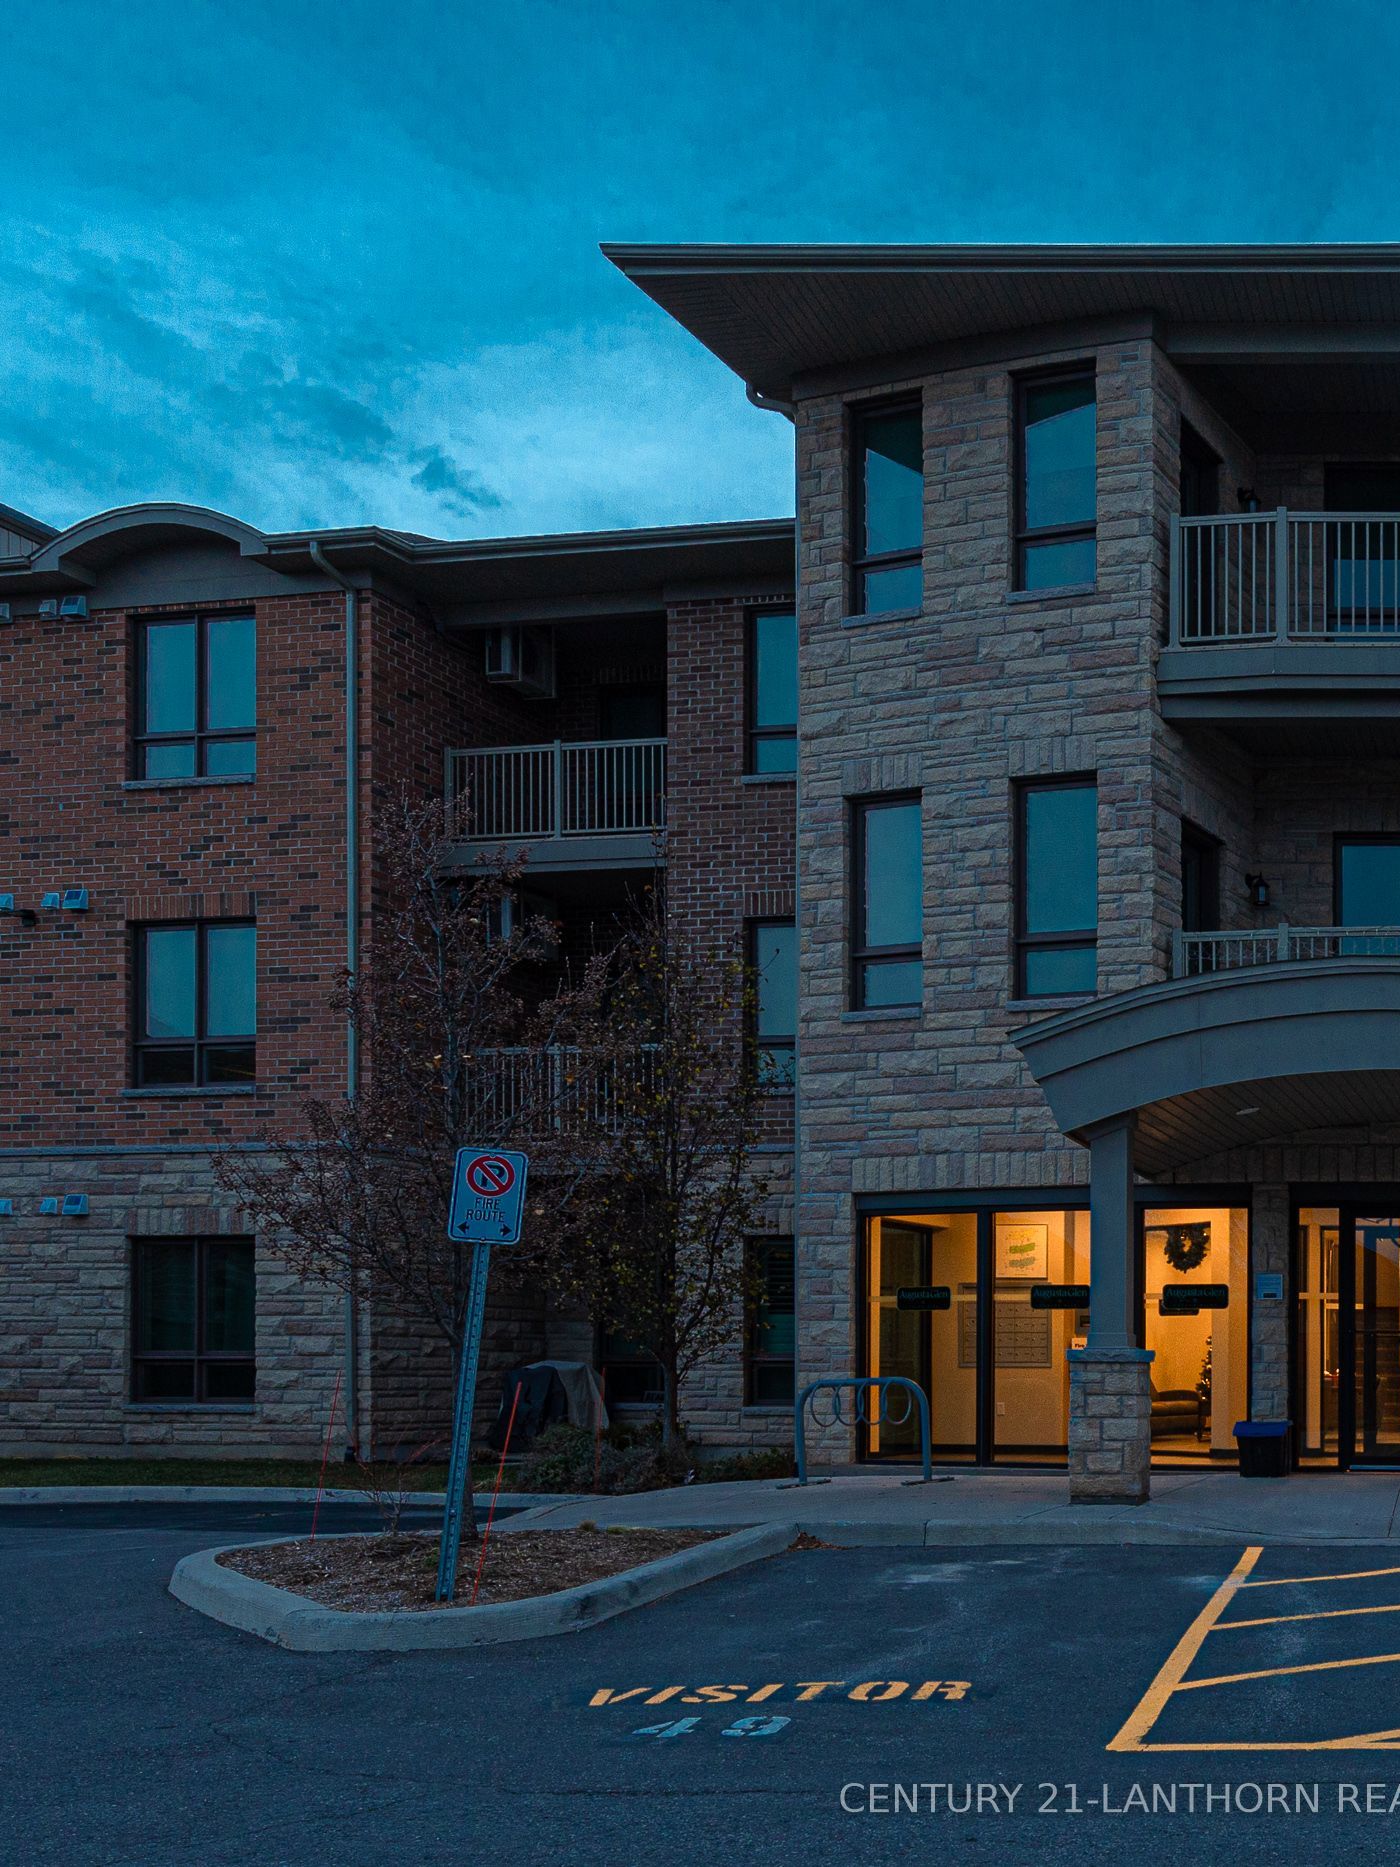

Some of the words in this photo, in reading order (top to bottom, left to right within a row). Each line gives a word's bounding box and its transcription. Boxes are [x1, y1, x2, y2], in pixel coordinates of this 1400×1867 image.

[474, 1197, 502, 1210] FIRE
[466, 1209, 506, 1223] ROUTE
[588, 1681, 973, 1706] VISITOR
